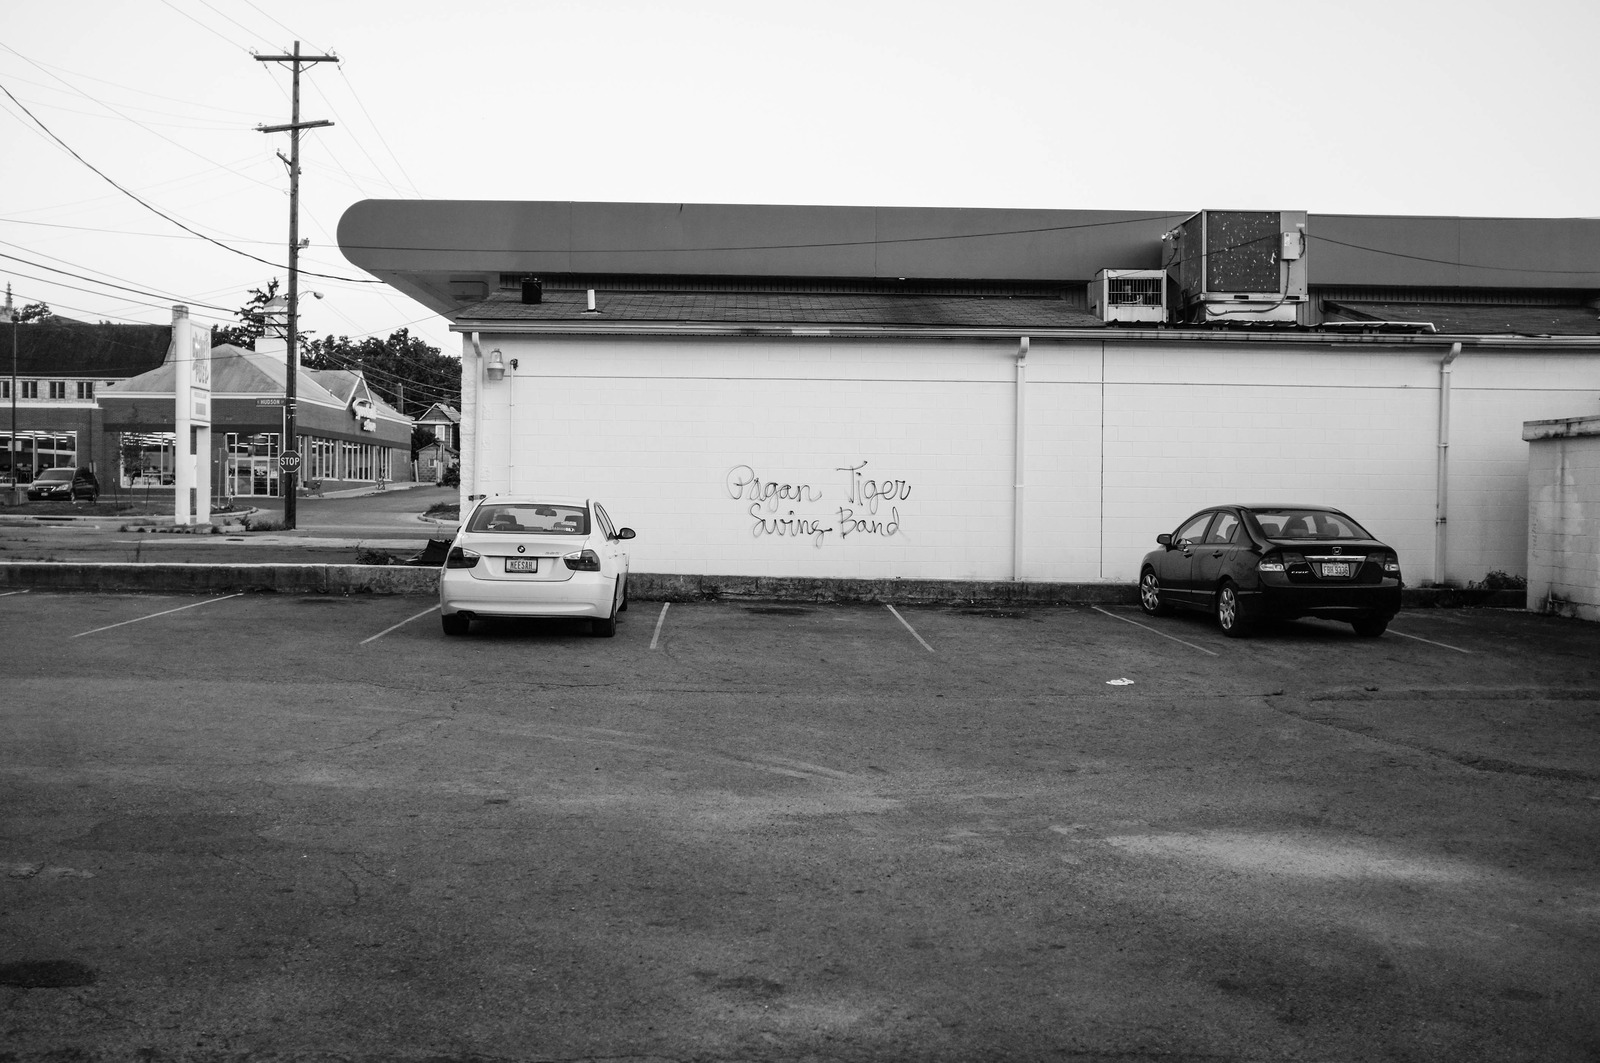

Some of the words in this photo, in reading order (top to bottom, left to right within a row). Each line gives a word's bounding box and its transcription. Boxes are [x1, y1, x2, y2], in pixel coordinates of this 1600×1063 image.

[280, 457, 300, 466] STOP
[726, 464, 823, 513] Pagan
[836, 460, 911, 515] Tiger
[836, 506, 900, 539] Band
